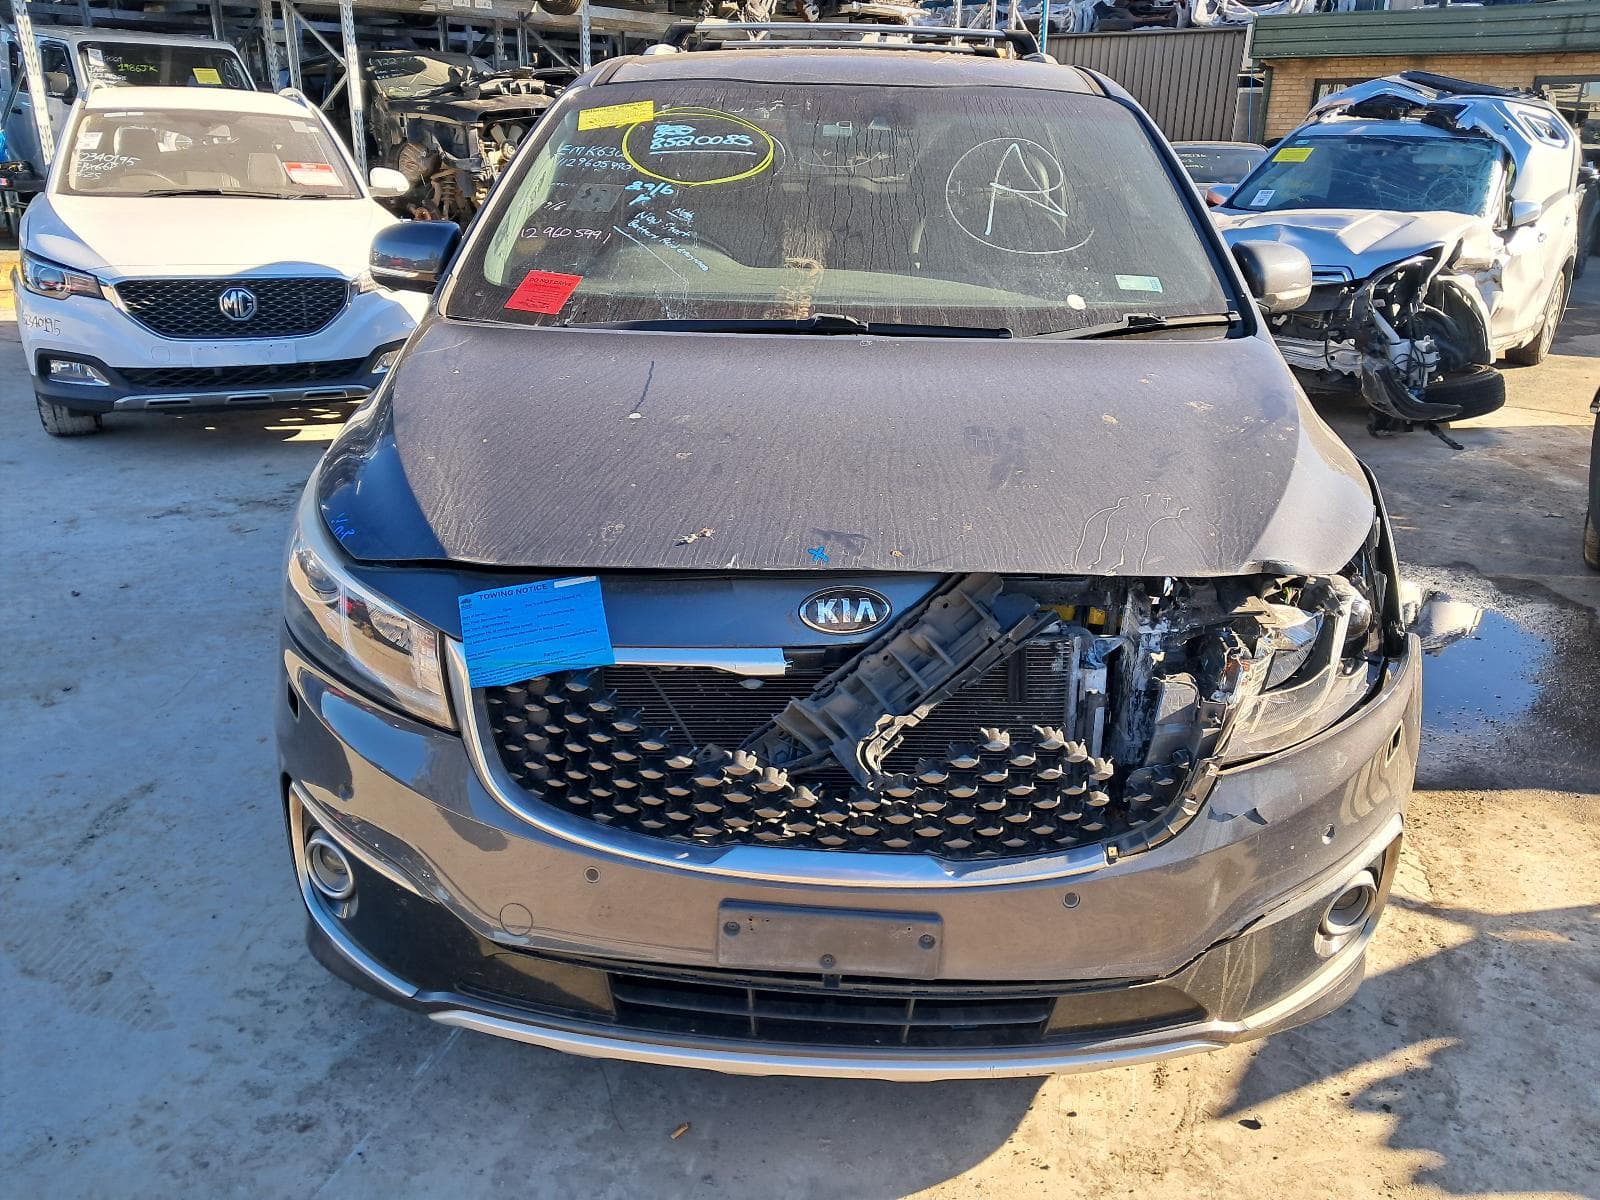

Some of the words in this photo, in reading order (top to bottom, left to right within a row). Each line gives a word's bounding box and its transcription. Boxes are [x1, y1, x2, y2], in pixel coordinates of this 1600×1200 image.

[223, 290, 253, 318] MG
[478, 589, 514, 601] TOWING
[515, 583, 549, 595] NOTICE
[816, 597, 877, 624] KIA
